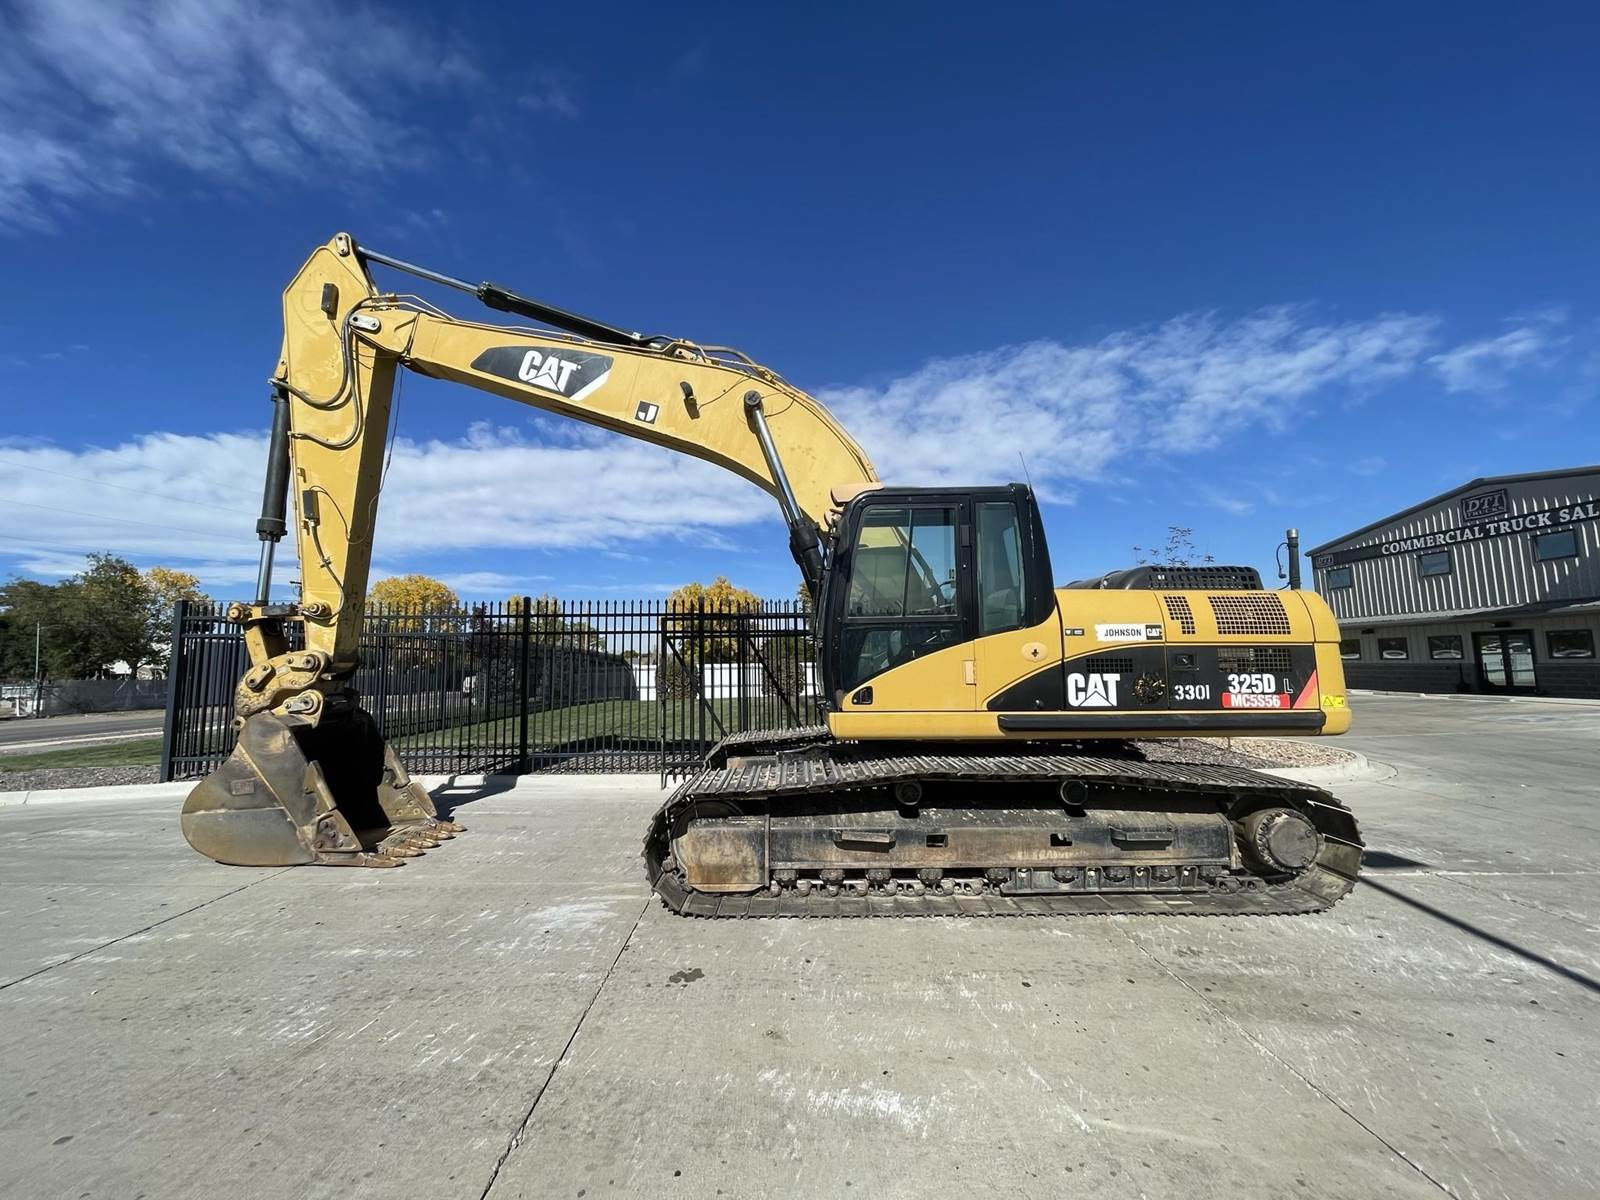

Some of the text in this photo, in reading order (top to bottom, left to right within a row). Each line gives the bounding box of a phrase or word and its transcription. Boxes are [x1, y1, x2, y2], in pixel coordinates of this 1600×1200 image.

[518, 350, 578, 393] CAT
[1466, 494, 1502, 513] DTI
[1382, 526, 1484, 554] COMMERCIAL
[1486, 513, 1552, 536] TRUCK
[1104, 628, 1142, 637] JOHNSON
[1067, 673, 1120, 707] CAT
[1228, 673, 1294, 694] 325D L
